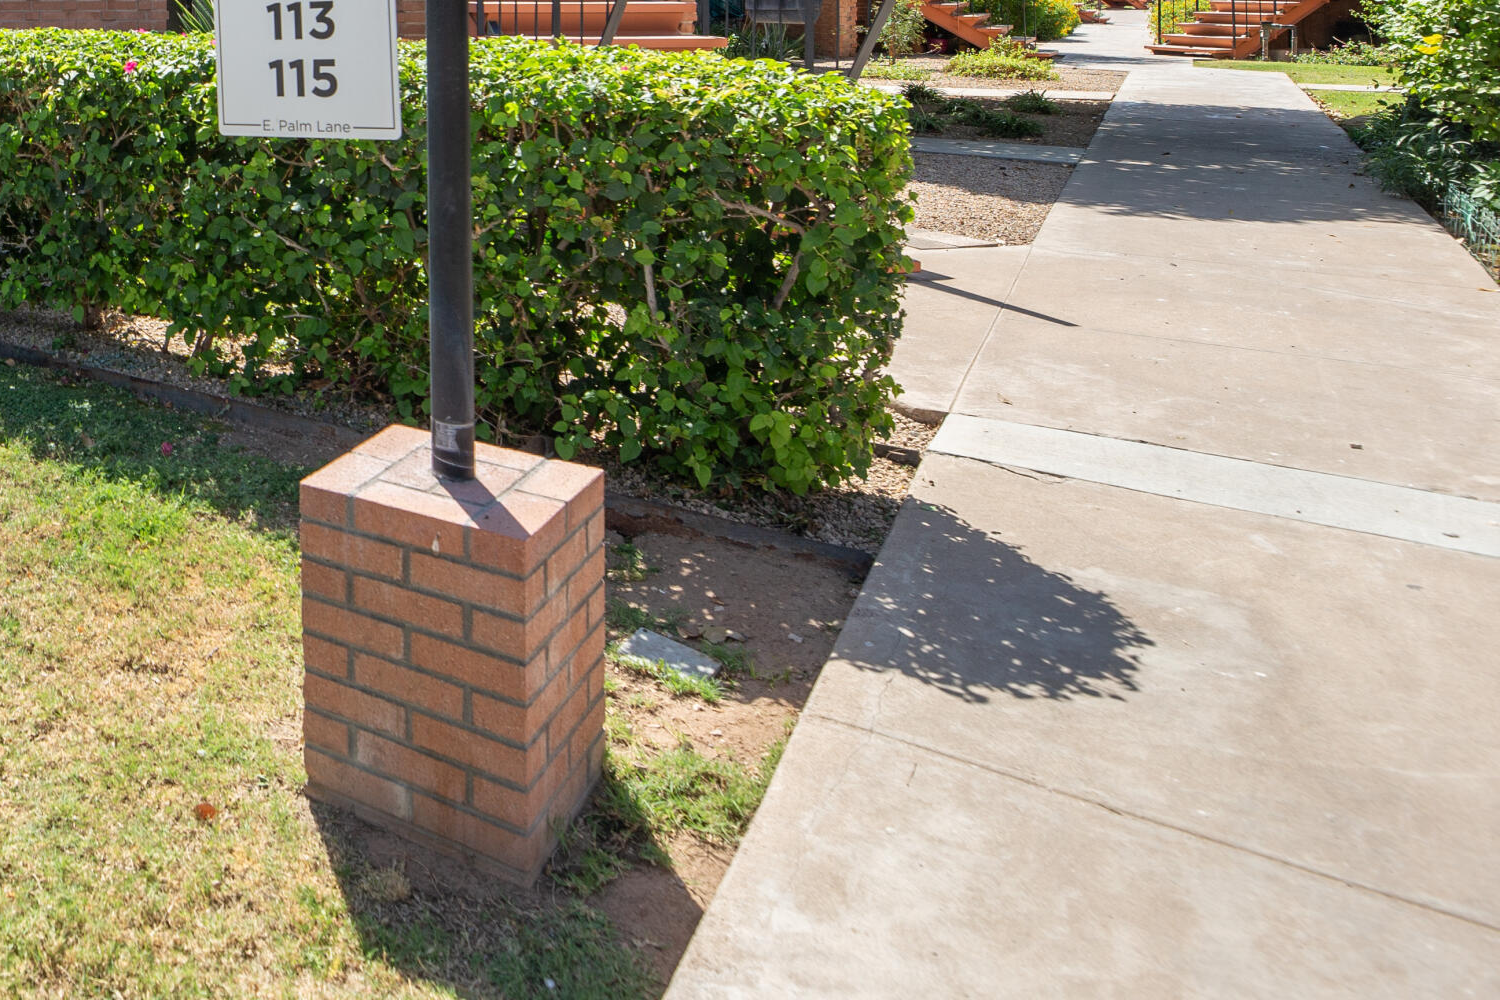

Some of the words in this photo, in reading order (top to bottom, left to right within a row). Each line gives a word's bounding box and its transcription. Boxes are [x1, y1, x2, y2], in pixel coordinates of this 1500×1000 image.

[266, 1, 335, 41] 113
[268, 59, 338, 98] 115
[262, 119, 275, 132] E.
[279, 120, 312, 133] Palm
[317, 120, 351, 133] Lane
